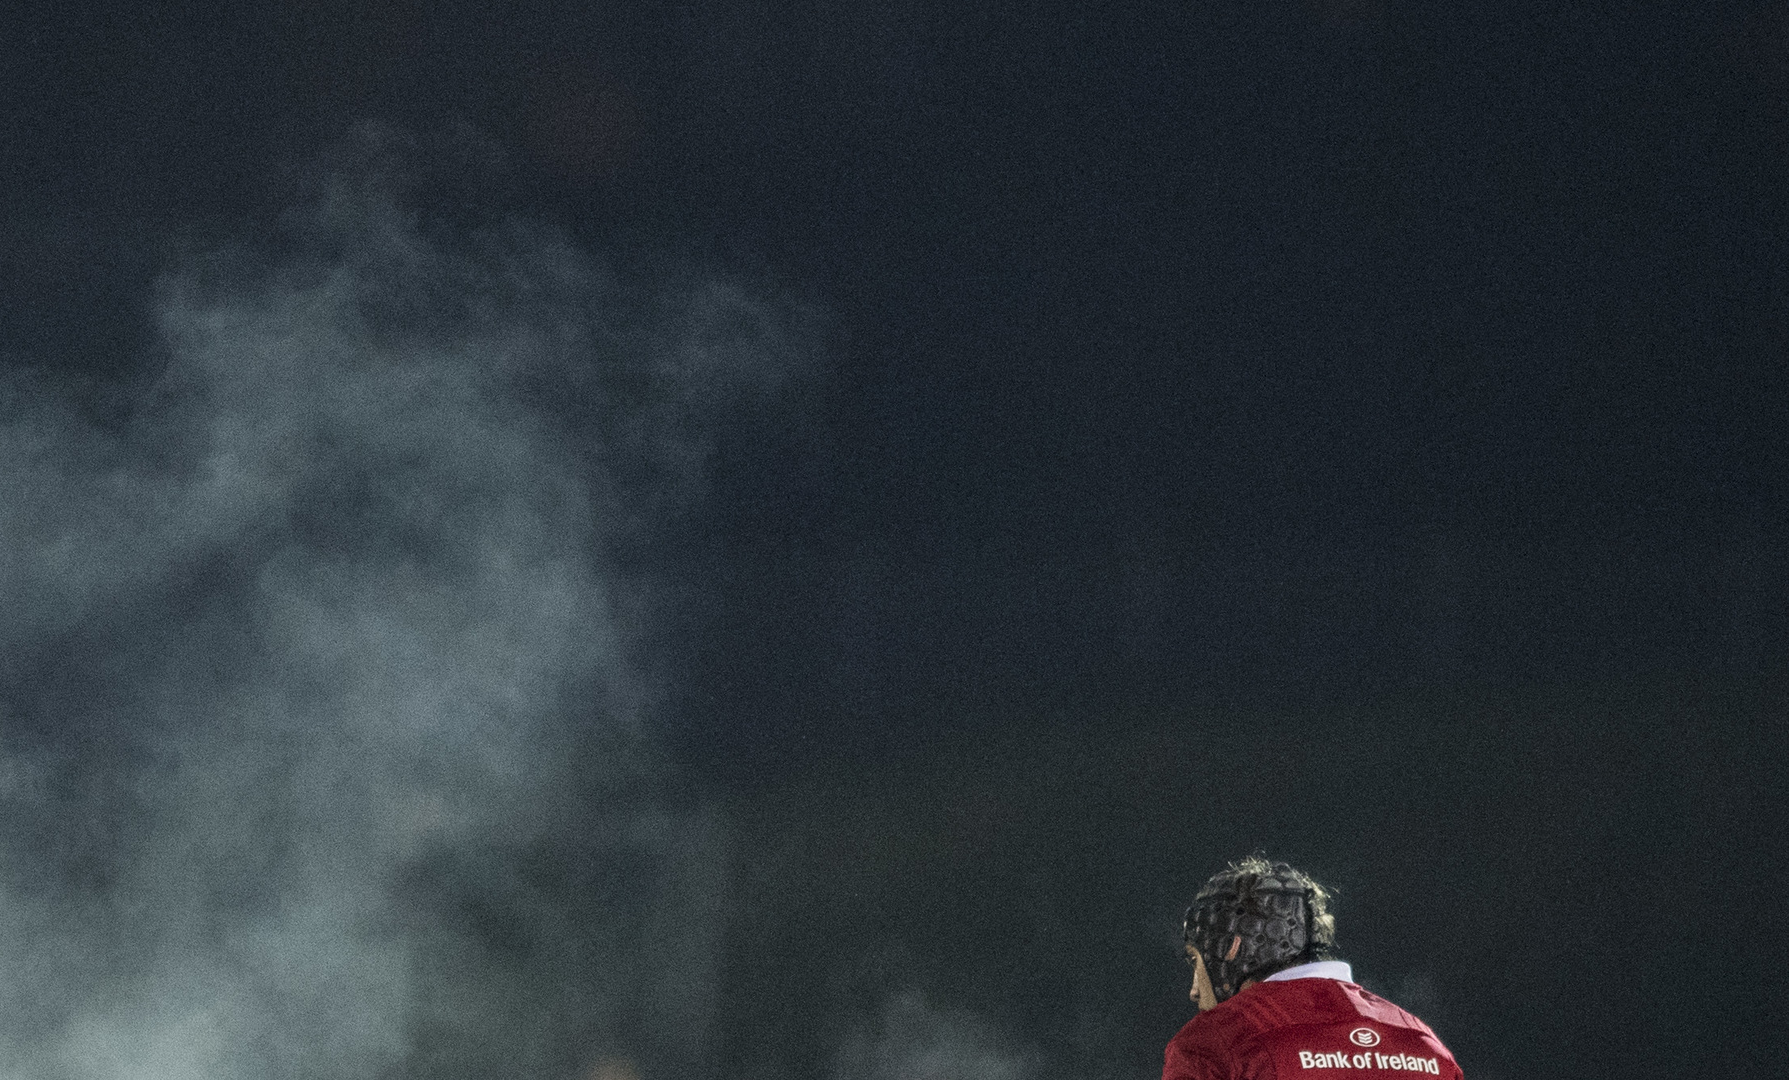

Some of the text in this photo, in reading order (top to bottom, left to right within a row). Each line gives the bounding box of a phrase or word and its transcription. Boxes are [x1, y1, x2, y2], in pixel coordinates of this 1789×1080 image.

[1299, 1051, 1440, 1075] Bank of Ireland
